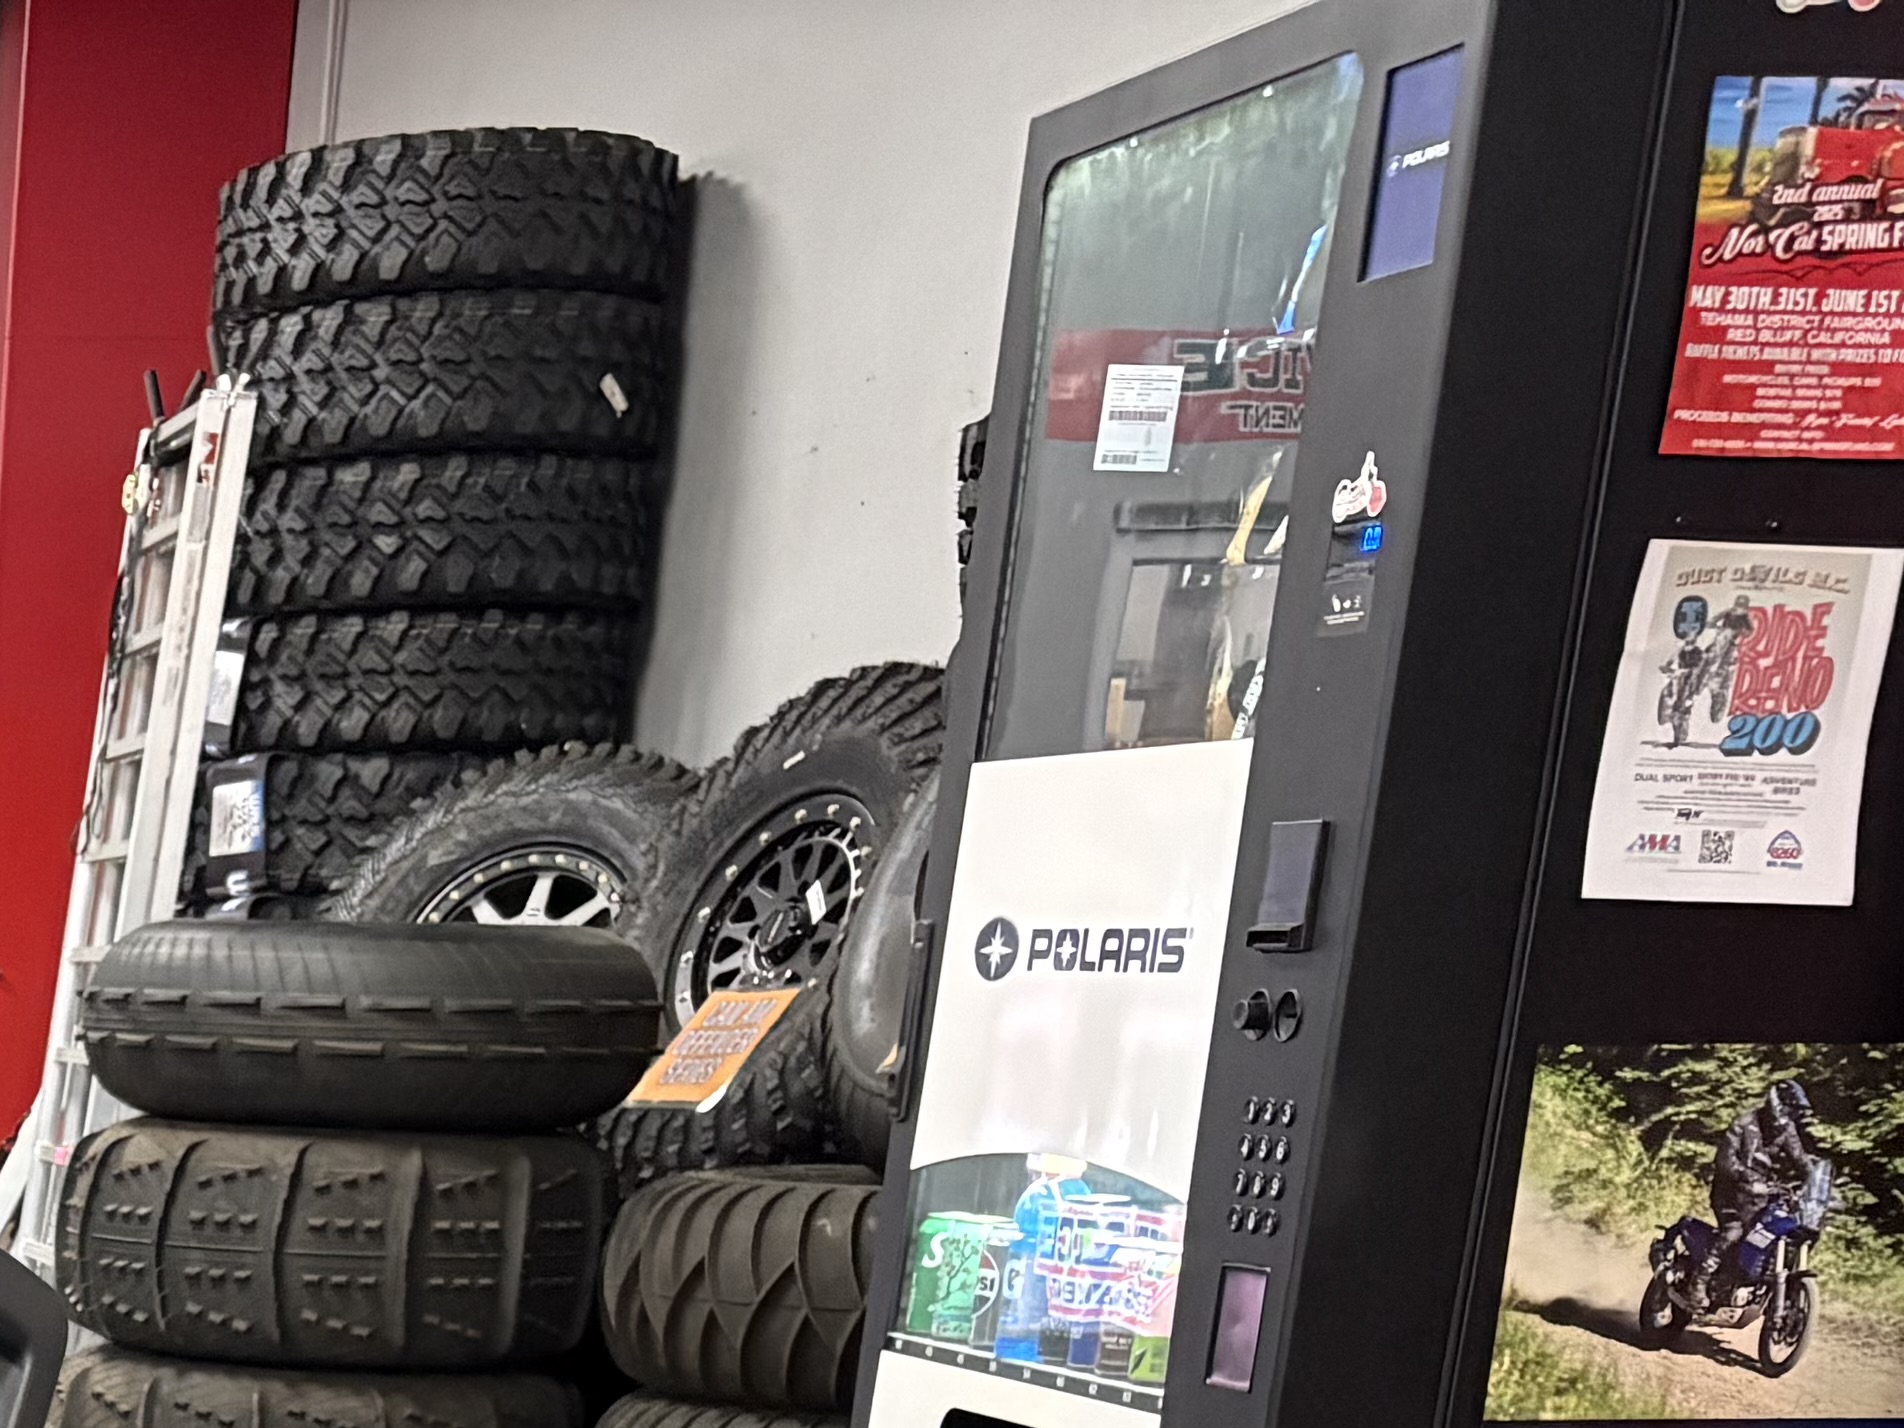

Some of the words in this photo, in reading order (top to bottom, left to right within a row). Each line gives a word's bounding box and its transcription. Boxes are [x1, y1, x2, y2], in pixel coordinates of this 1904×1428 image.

[1772, 182, 1812, 205] 2nd
[1812, 178, 1884, 203] annual
[1820, 221, 1891, 252] SPRING
[1689, 285, 1726, 308] MAY
[1821, 288, 1868, 313] JUNE
[1869, 290, 1899, 313] 1ST
[1757, 314, 1822, 329] DISTRICT
[1727, 328, 1756, 341] RED
[1807, 330, 1891, 345] CALIFORNIA
[1675, 567, 1727, 587] DUST
[1730, 563, 1808, 586] DEVILS
[1738, 602, 1835, 657] RIDE
[1727, 654, 1835, 717] RENO
[1718, 711, 1822, 757] 200
[1026, 928, 1187, 974] POLARIS
